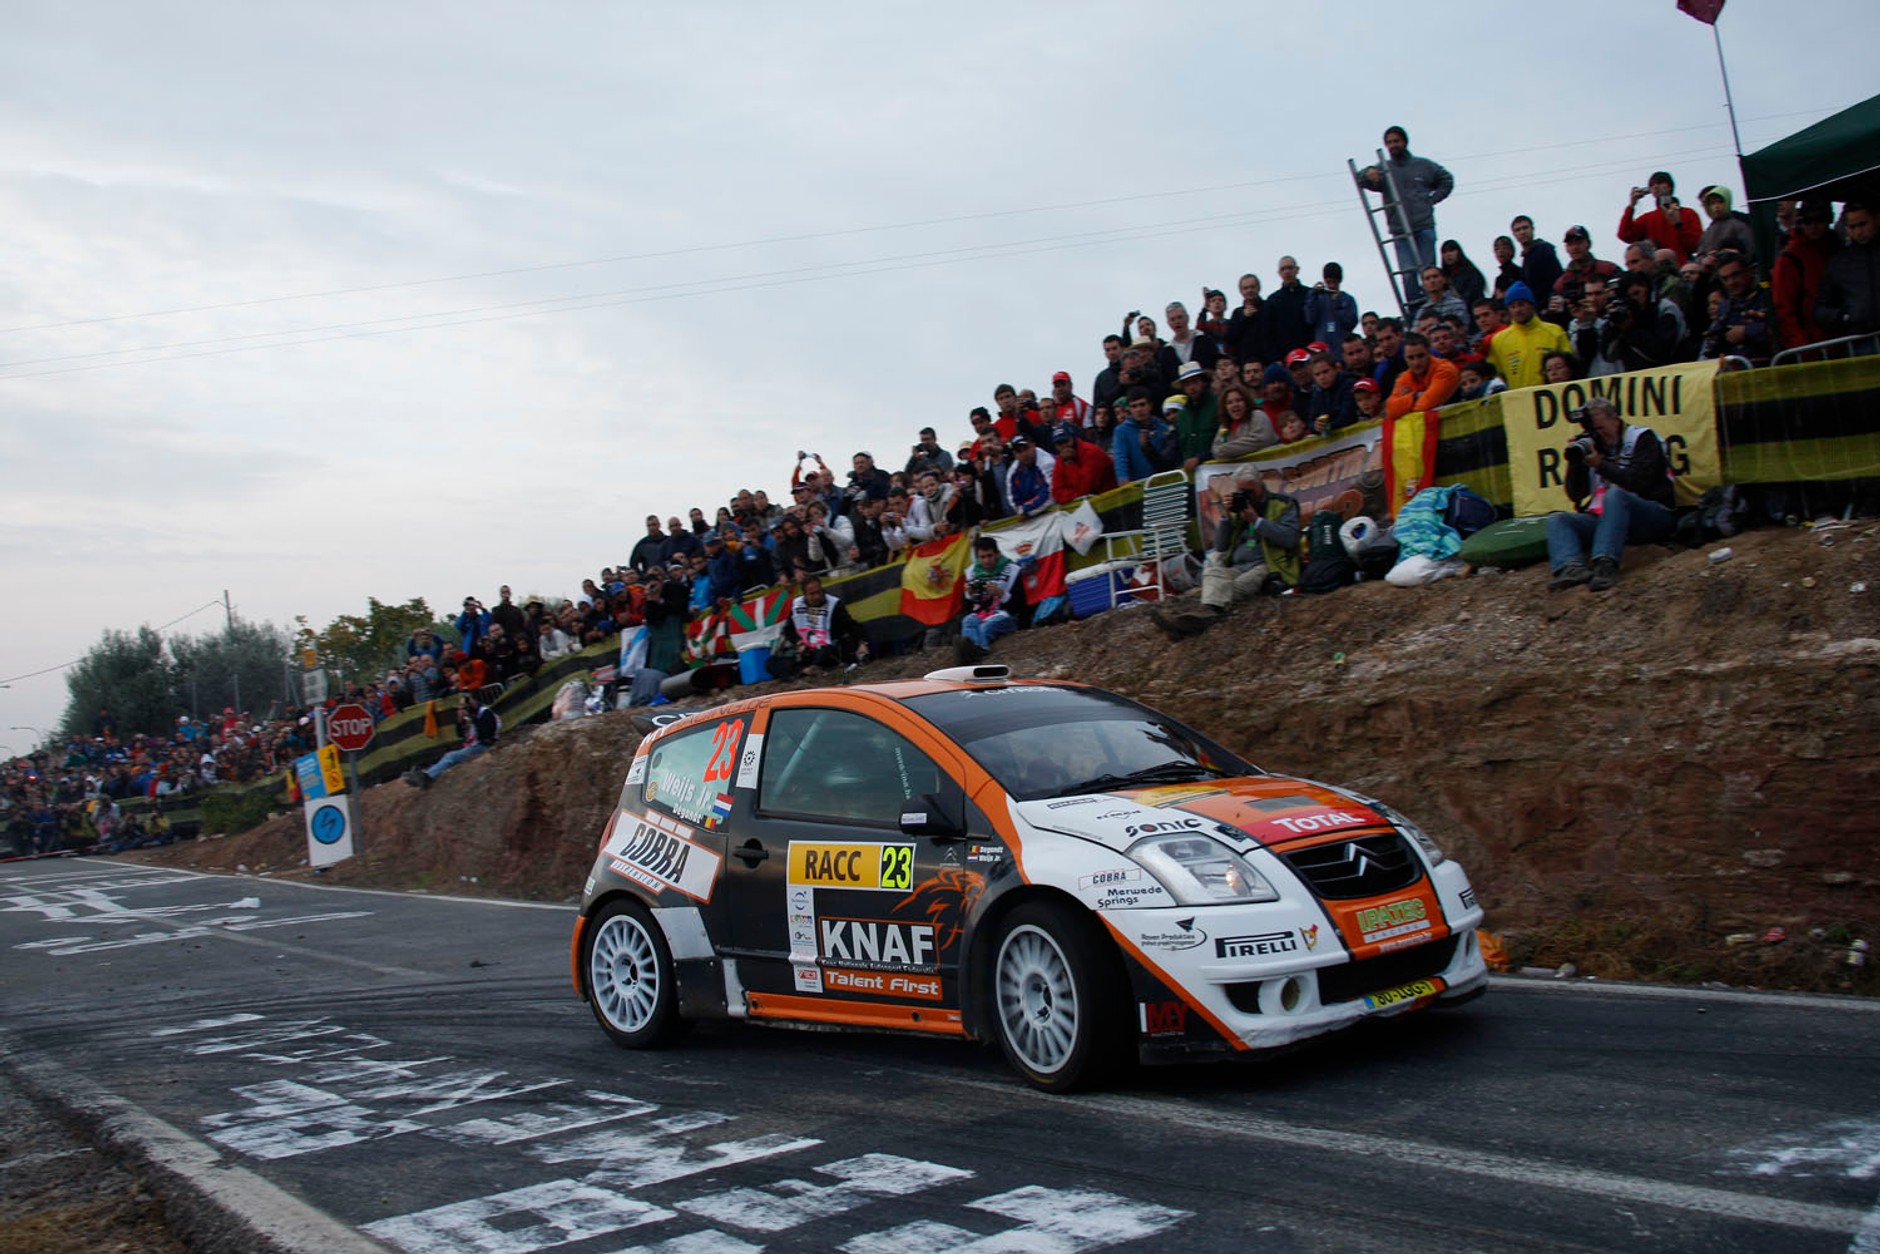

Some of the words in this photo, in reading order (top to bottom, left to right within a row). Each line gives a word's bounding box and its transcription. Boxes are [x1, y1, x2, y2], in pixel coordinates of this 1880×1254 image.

[1534, 374, 1683, 430] DOMINI
[331, 717, 372, 737] STOP
[703, 718, 744, 783] 23
[1272, 811, 1366, 833] TOTAL
[619, 822, 691, 884] COBRA
[804, 850, 862, 882] RACC
[881, 846, 912, 889] 23
[1092, 872, 1127, 884] COBRA
[1107, 886, 1163, 896] Merwede
[1097, 896, 1139, 908] Springs
[821, 920, 934, 965] KNAF
[1215, 930, 1298, 959] PIRELLI
[826, 971, 884, 989] Talent
[890, 978, 939, 995] First
